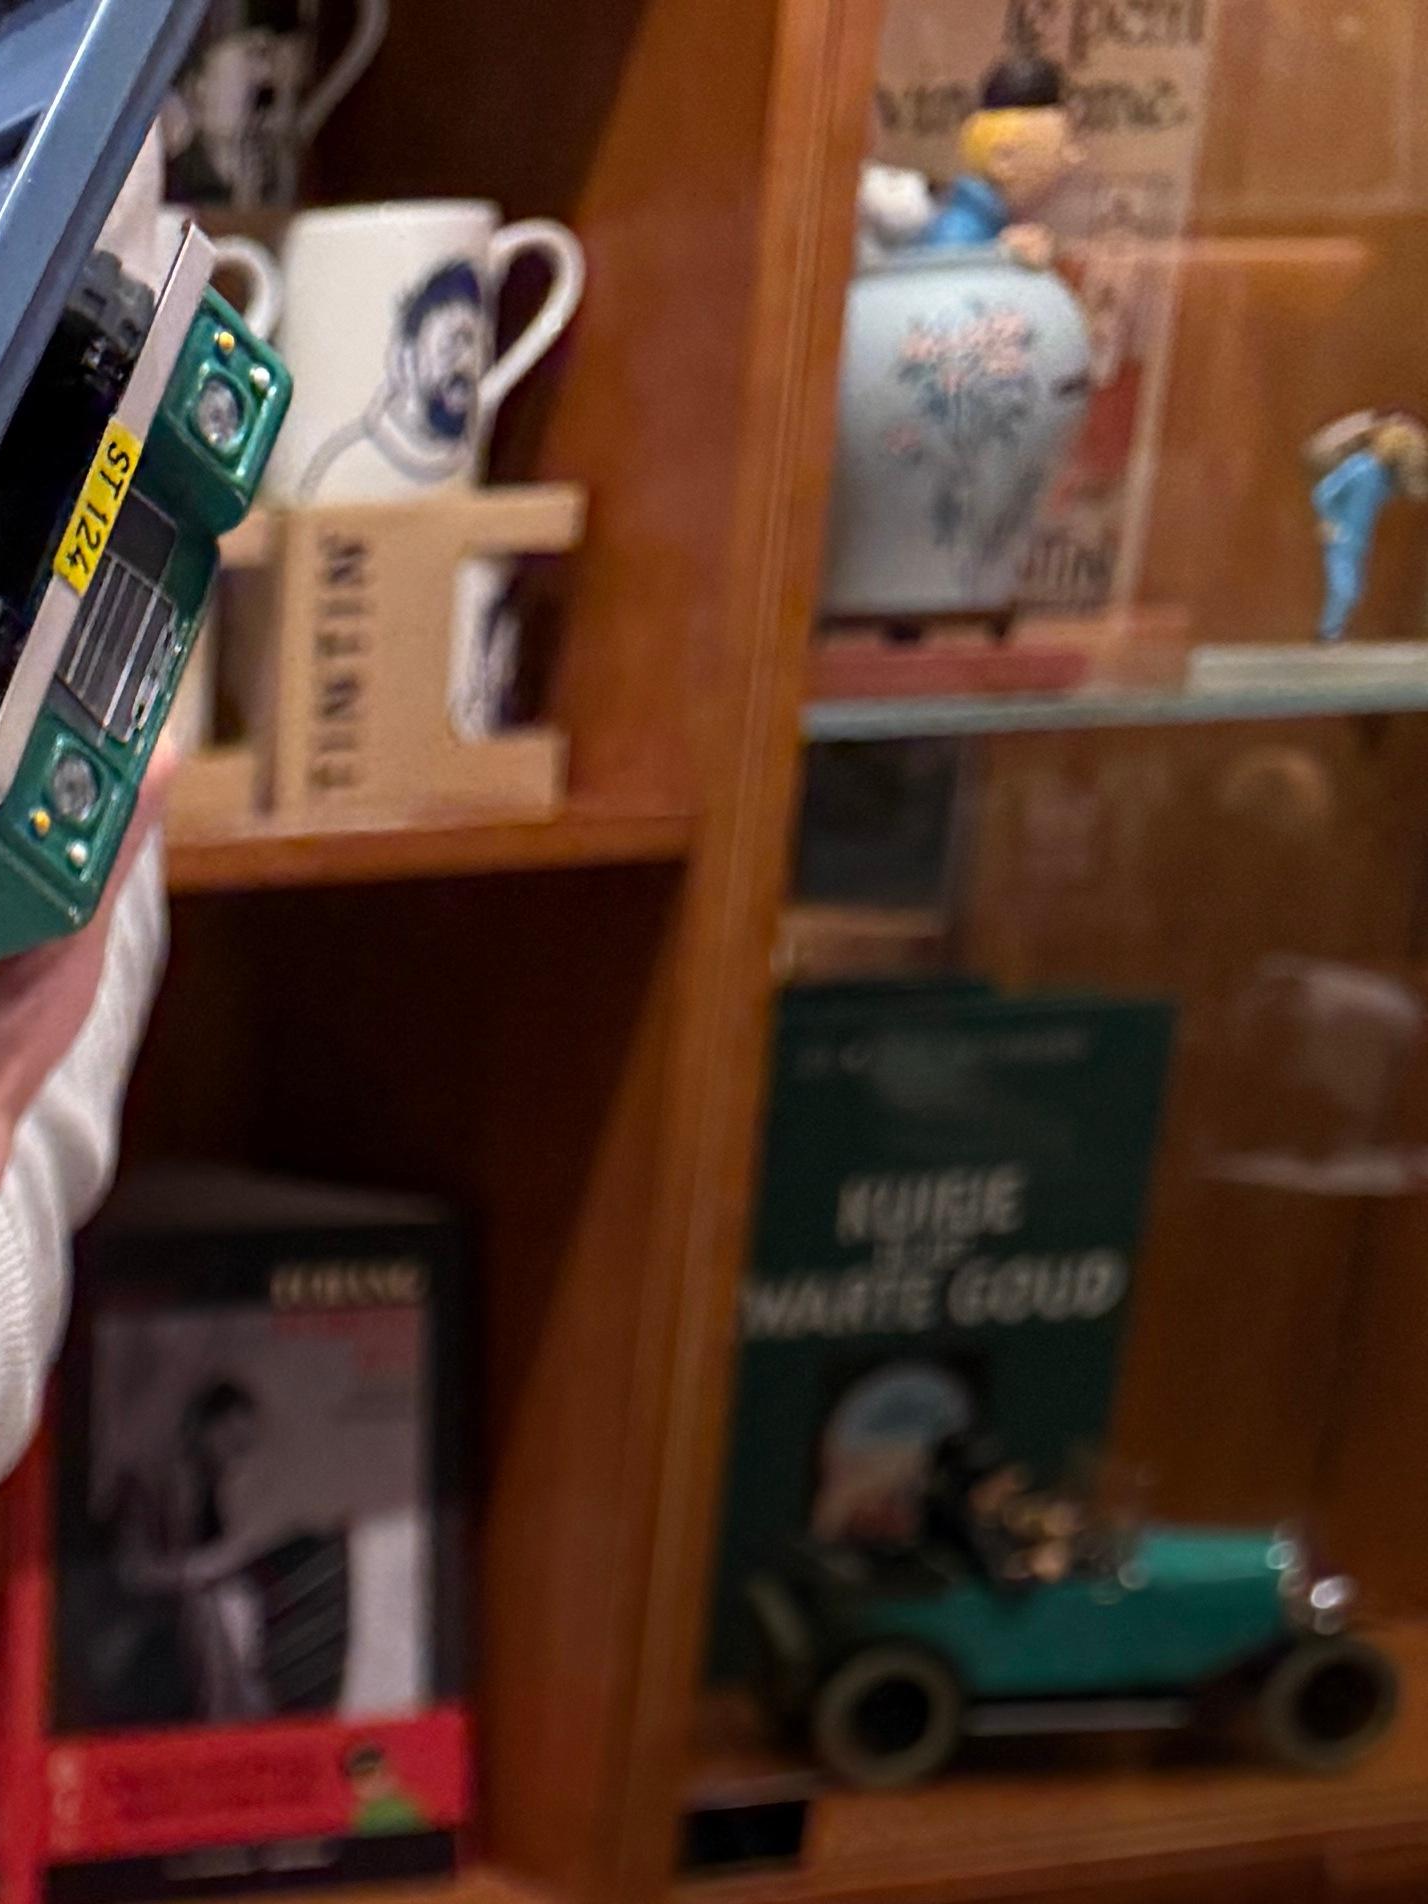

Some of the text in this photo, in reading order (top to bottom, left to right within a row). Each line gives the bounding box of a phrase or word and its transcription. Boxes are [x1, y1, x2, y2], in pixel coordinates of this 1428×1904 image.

[65, 440, 131, 574] ST 124
[947, 1250, 1130, 1330] GOUD
